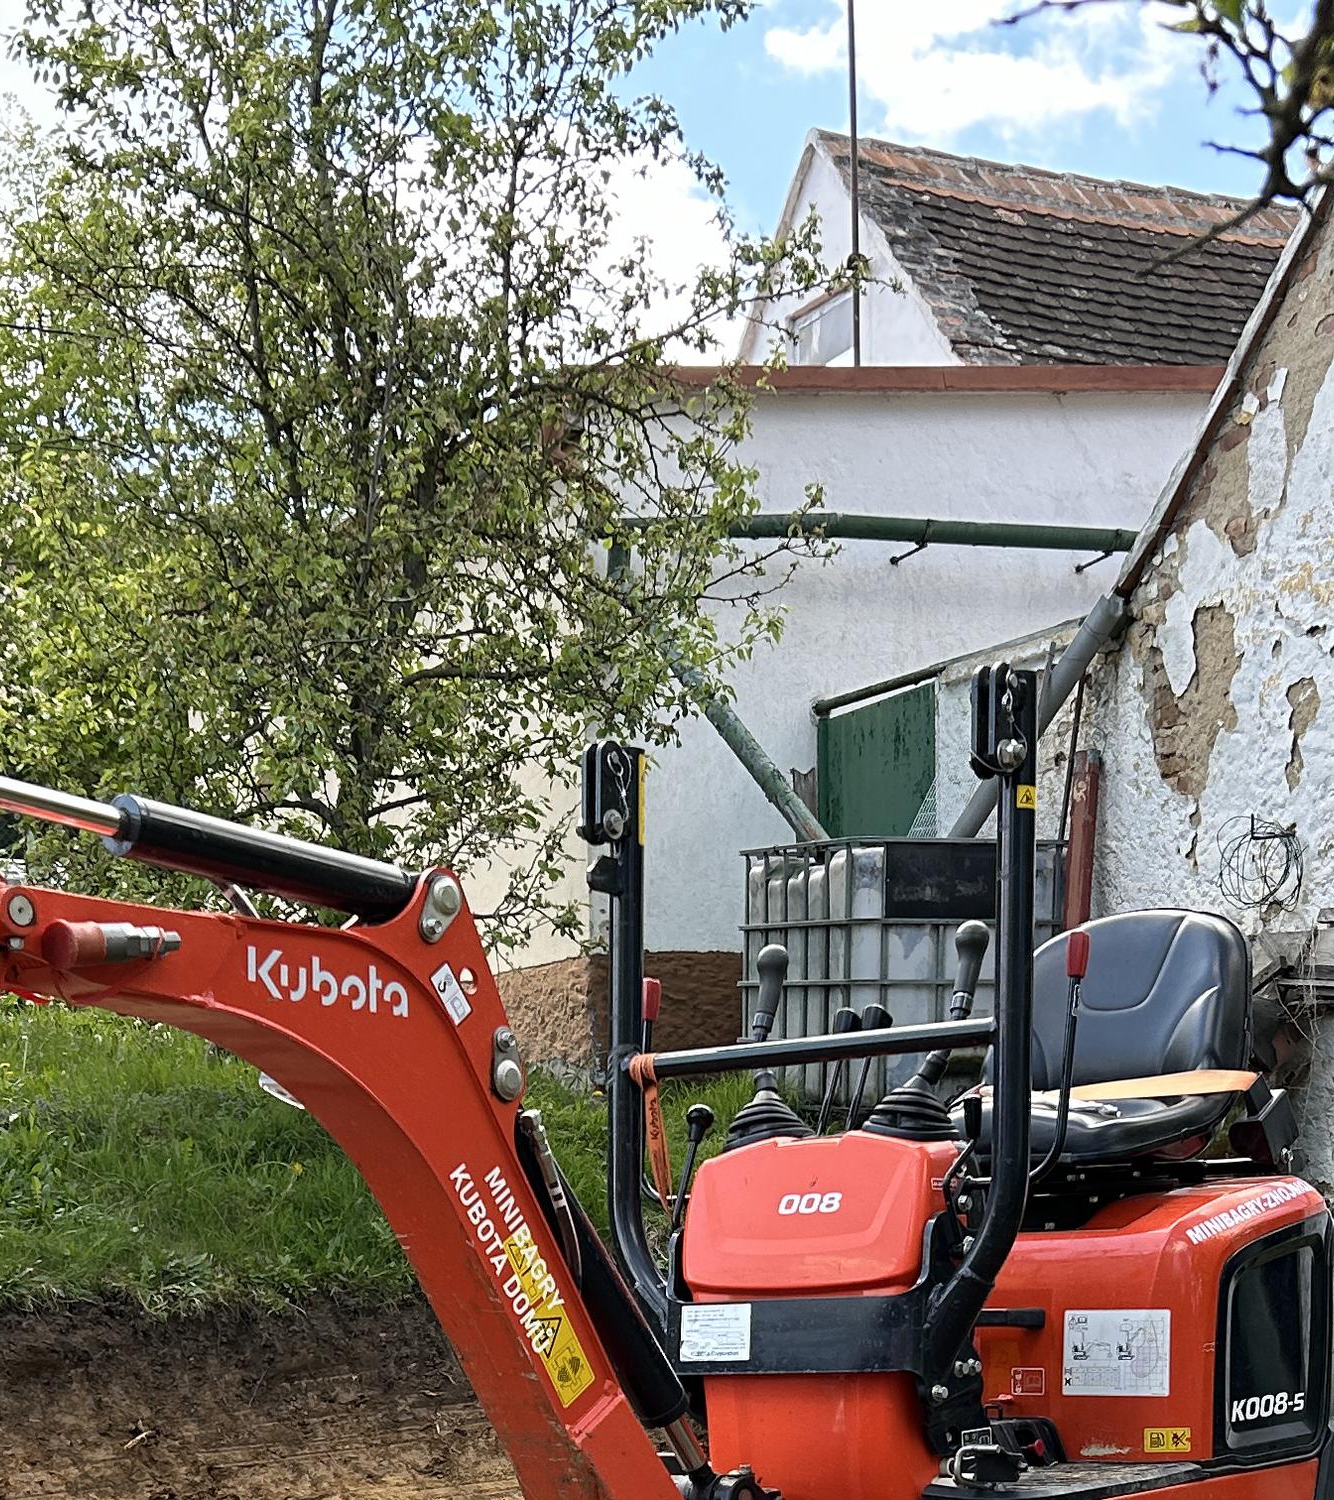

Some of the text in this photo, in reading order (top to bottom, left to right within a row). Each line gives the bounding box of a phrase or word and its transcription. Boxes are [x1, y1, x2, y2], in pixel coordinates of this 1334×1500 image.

[246, 945, 409, 1018] Kubota
[484, 1165, 565, 1311] MINIBAGRY
[777, 1191, 844, 1216] 008
[449, 1162, 554, 1355] KUBOTA DOMŮ
[1231, 1391, 1305, 1423] K008-5
